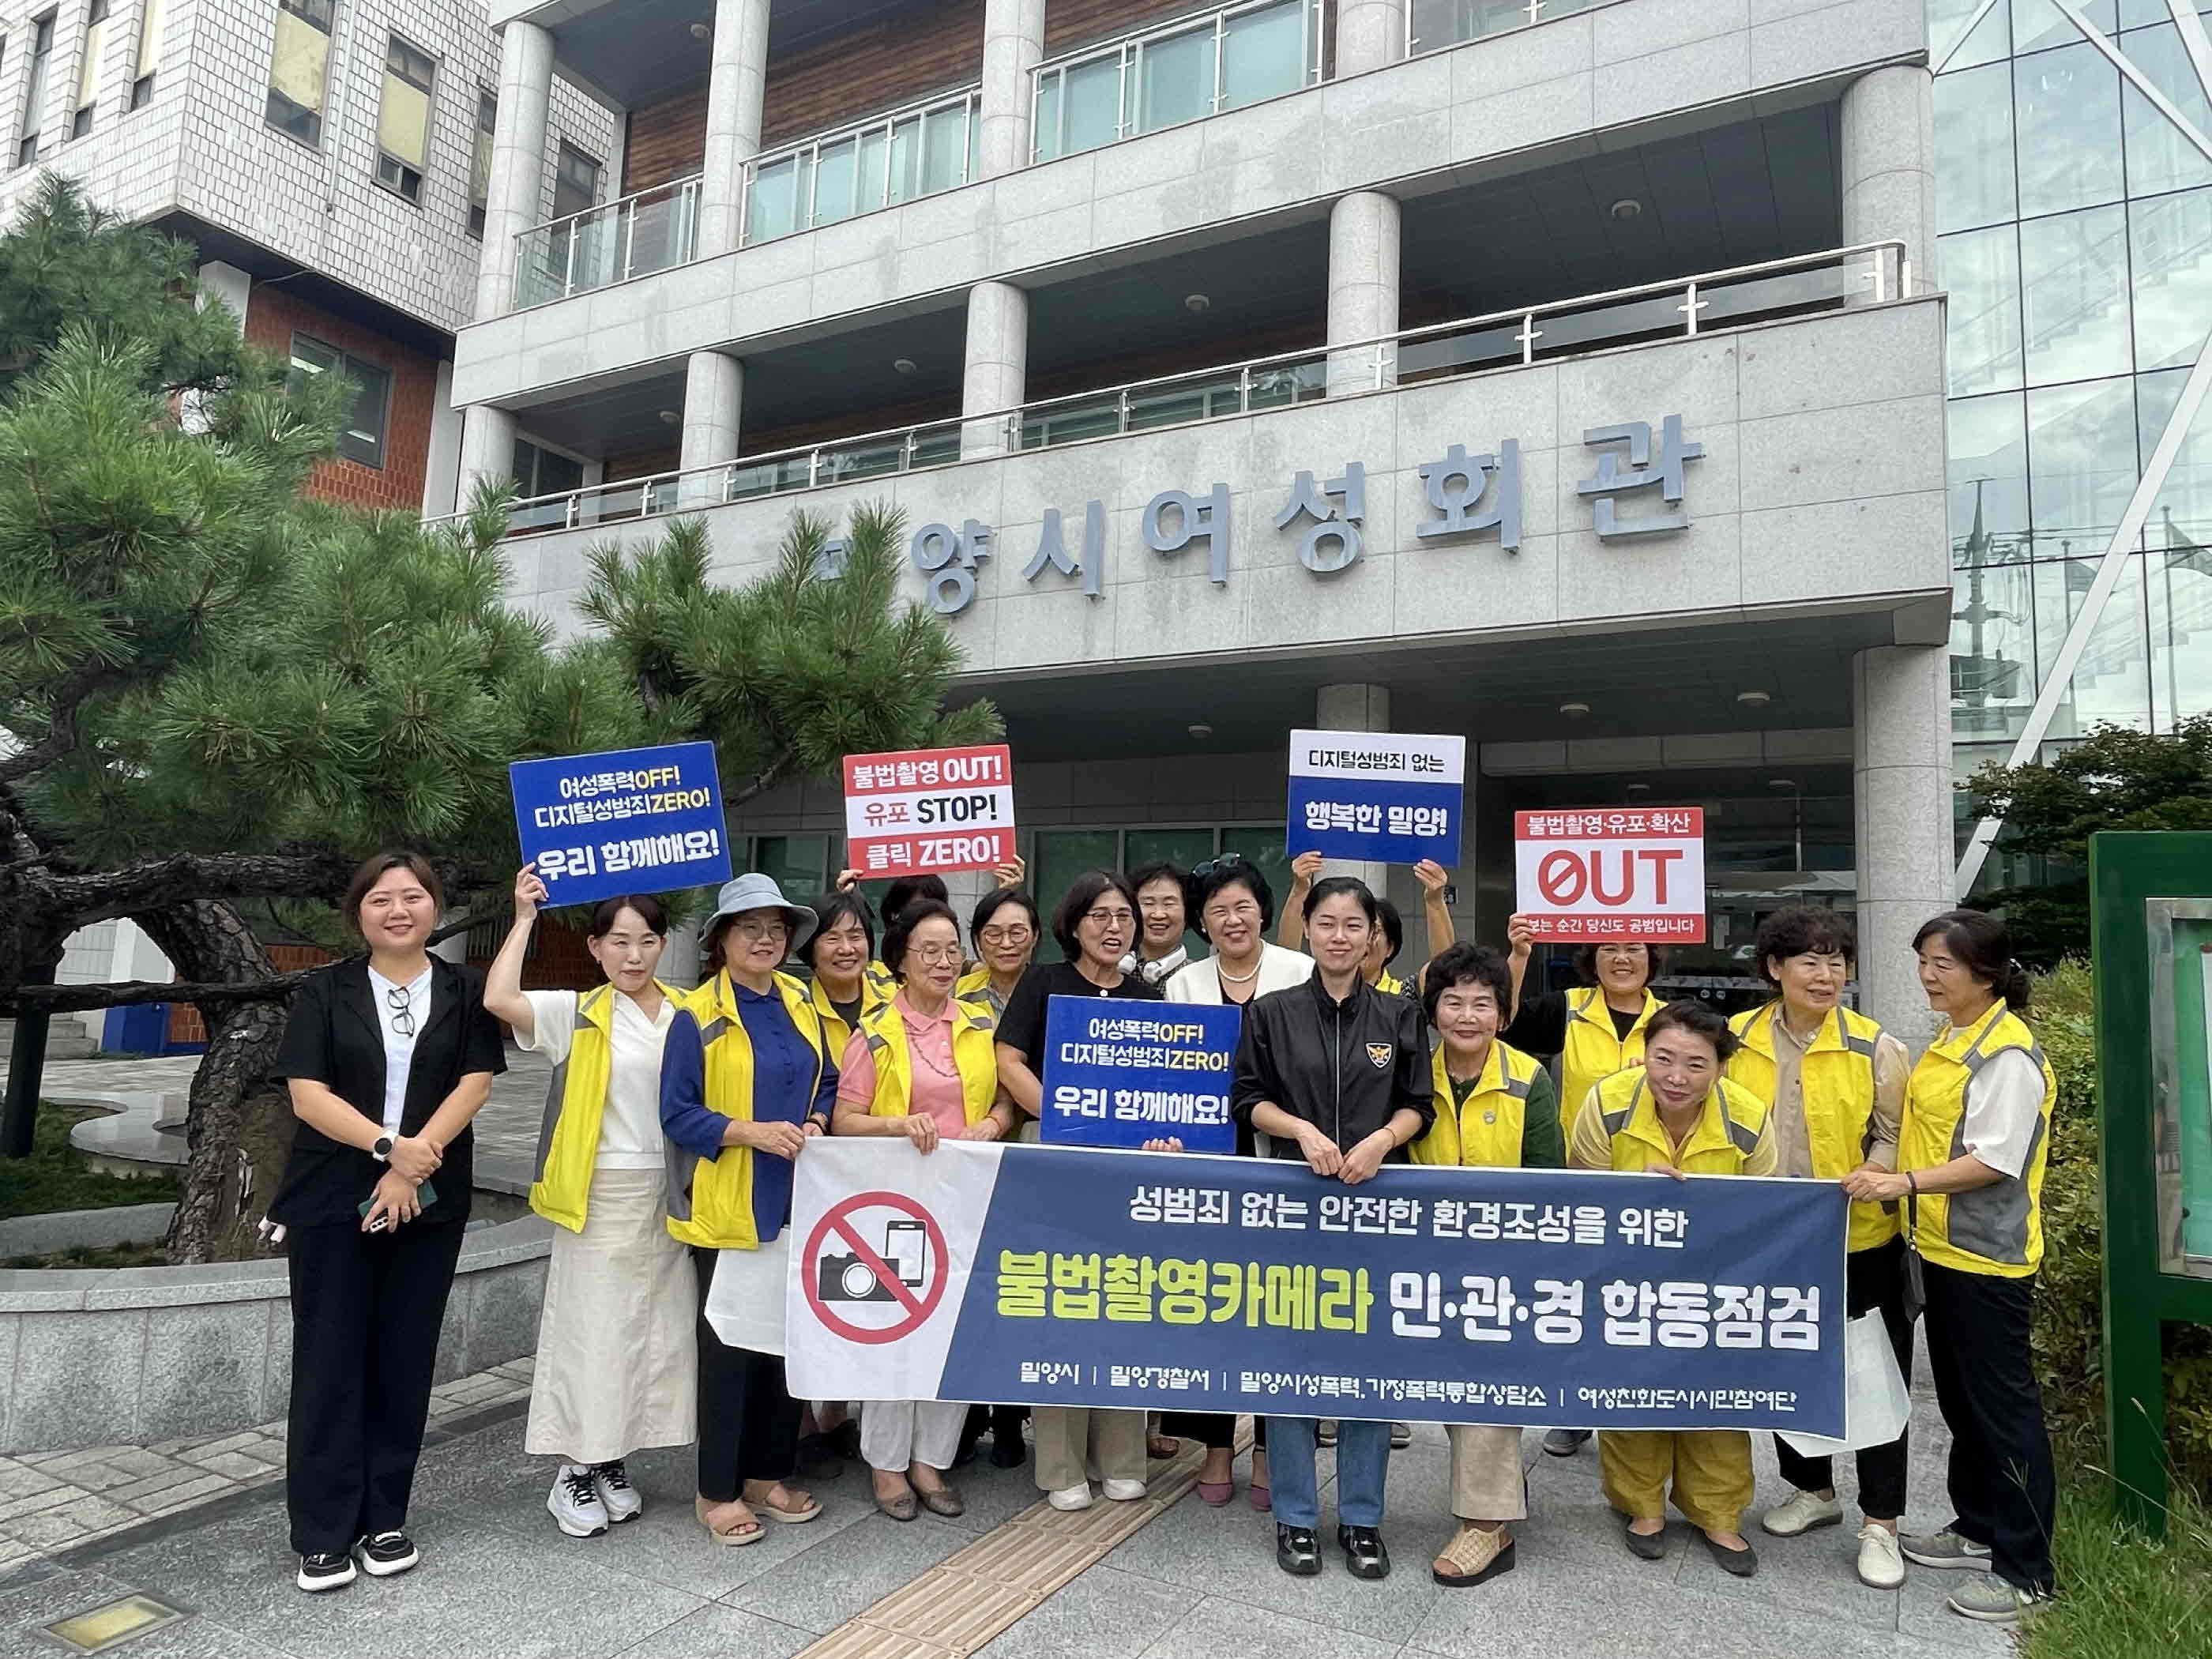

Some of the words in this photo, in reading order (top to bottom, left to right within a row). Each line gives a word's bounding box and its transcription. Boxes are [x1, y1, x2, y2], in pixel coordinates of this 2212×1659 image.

[852, 761, 939, 790] 불법촬영
[943, 754, 1003, 783] OUT!
[1308, 749, 1406, 771] 디지털성범죄
[1411, 753, 1445, 773] 없는
[559, 765, 681, 799] 여성폭력OFF!
[534, 787, 711, 829] 디지털성범죄ZERO!
[863, 801, 910, 827] 유포
[917, 794, 997, 823] STOP!
[1304, 800, 1382, 834] 행복한
[1387, 806, 1448, 837] 밀양!
[537, 847, 596, 882] 우리
[600, 828, 720, 872] 함께해요!
[865, 842, 912, 869] 클릭
[918, 835, 1001, 867] ZERO!
[1537, 848, 1684, 907] OUT
[1529, 918, 1553, 933] 보는
[1556, 918, 1582, 933] 순간
[1586, 918, 1625, 934] 당신도
[1629, 918, 1695, 934] 공범입니다
[1089, 1017, 1204, 1045] 여성폭력OFF!
[1060, 1041, 1229, 1073] 디지털성범죄ZERO!
[1053, 1085, 1107, 1120] 우리
[1114, 1089, 1229, 1126] 함께해요!
[1130, 1184, 1230, 1224] 성범죄
[1240, 1191, 1308, 1230] 없는
[1319, 1194, 1423, 1236] 안전한
[1431, 1198, 1607, 1246] 환경조성을
[1616, 1206, 1690, 1249] 위한
[996, 1248, 1375, 1335] 불법촬영카메라
[1600, 1278, 1820, 1352] 합동점검
[1021, 1361, 1080, 1386] 밀양시
[1109, 1364, 1210, 1391] 밀양경찰서
[1578, 1386, 1797, 1413] 여성친화도시시민참여단
